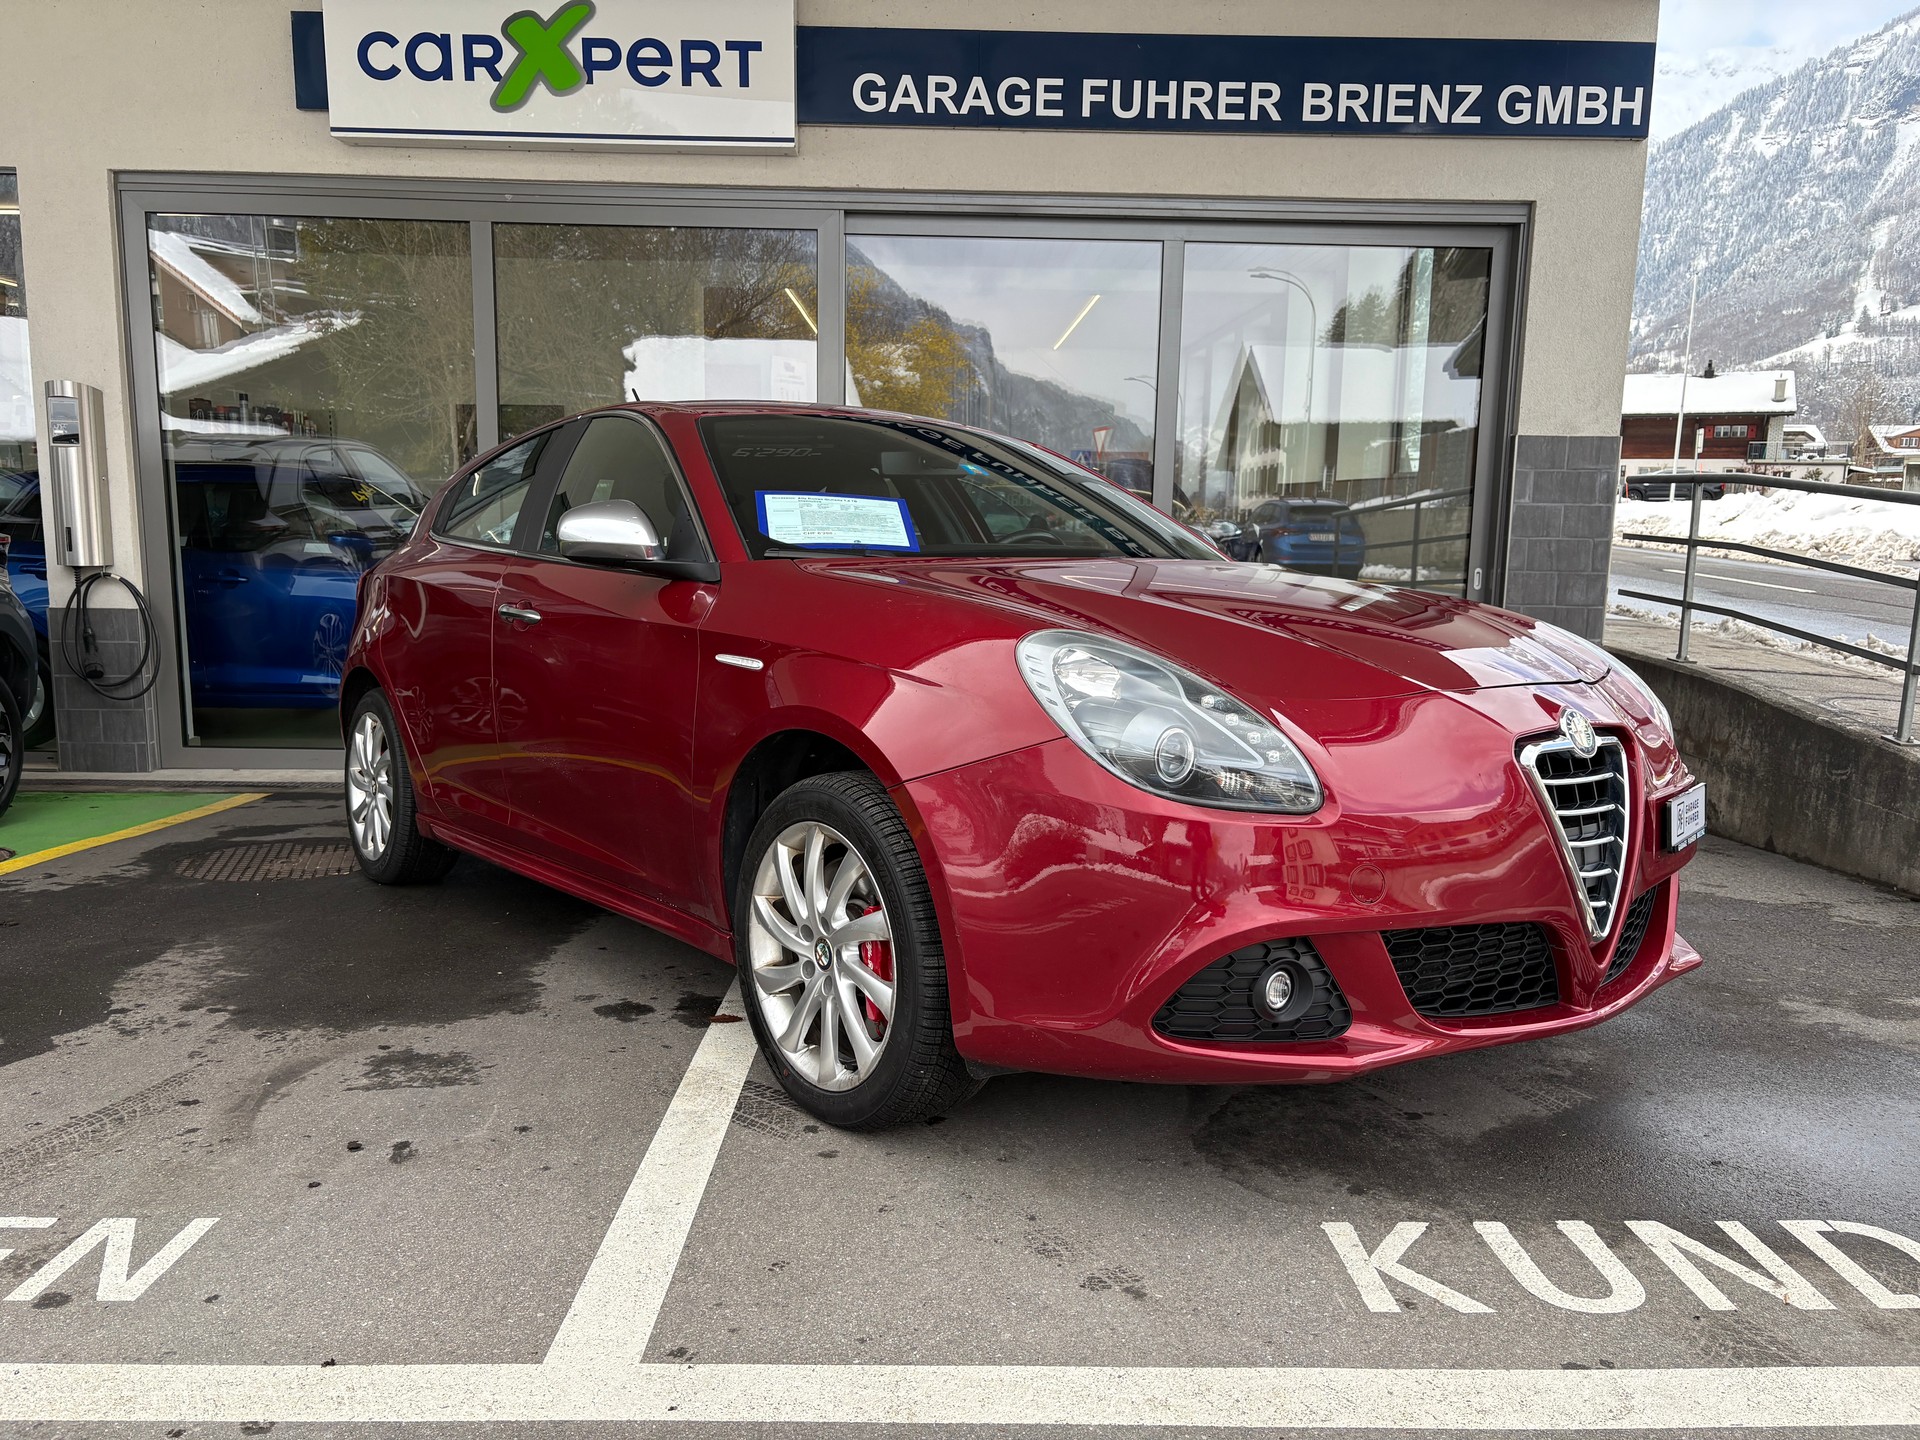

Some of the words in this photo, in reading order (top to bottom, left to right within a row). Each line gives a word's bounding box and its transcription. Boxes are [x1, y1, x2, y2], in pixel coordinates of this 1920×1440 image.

[852, 73, 1064, 117] GARAGE
[1081, 78, 1282, 121] FUHRER
[1302, 82, 1483, 124] BRIENZ
[1497, 85, 1644, 126] GMBH
